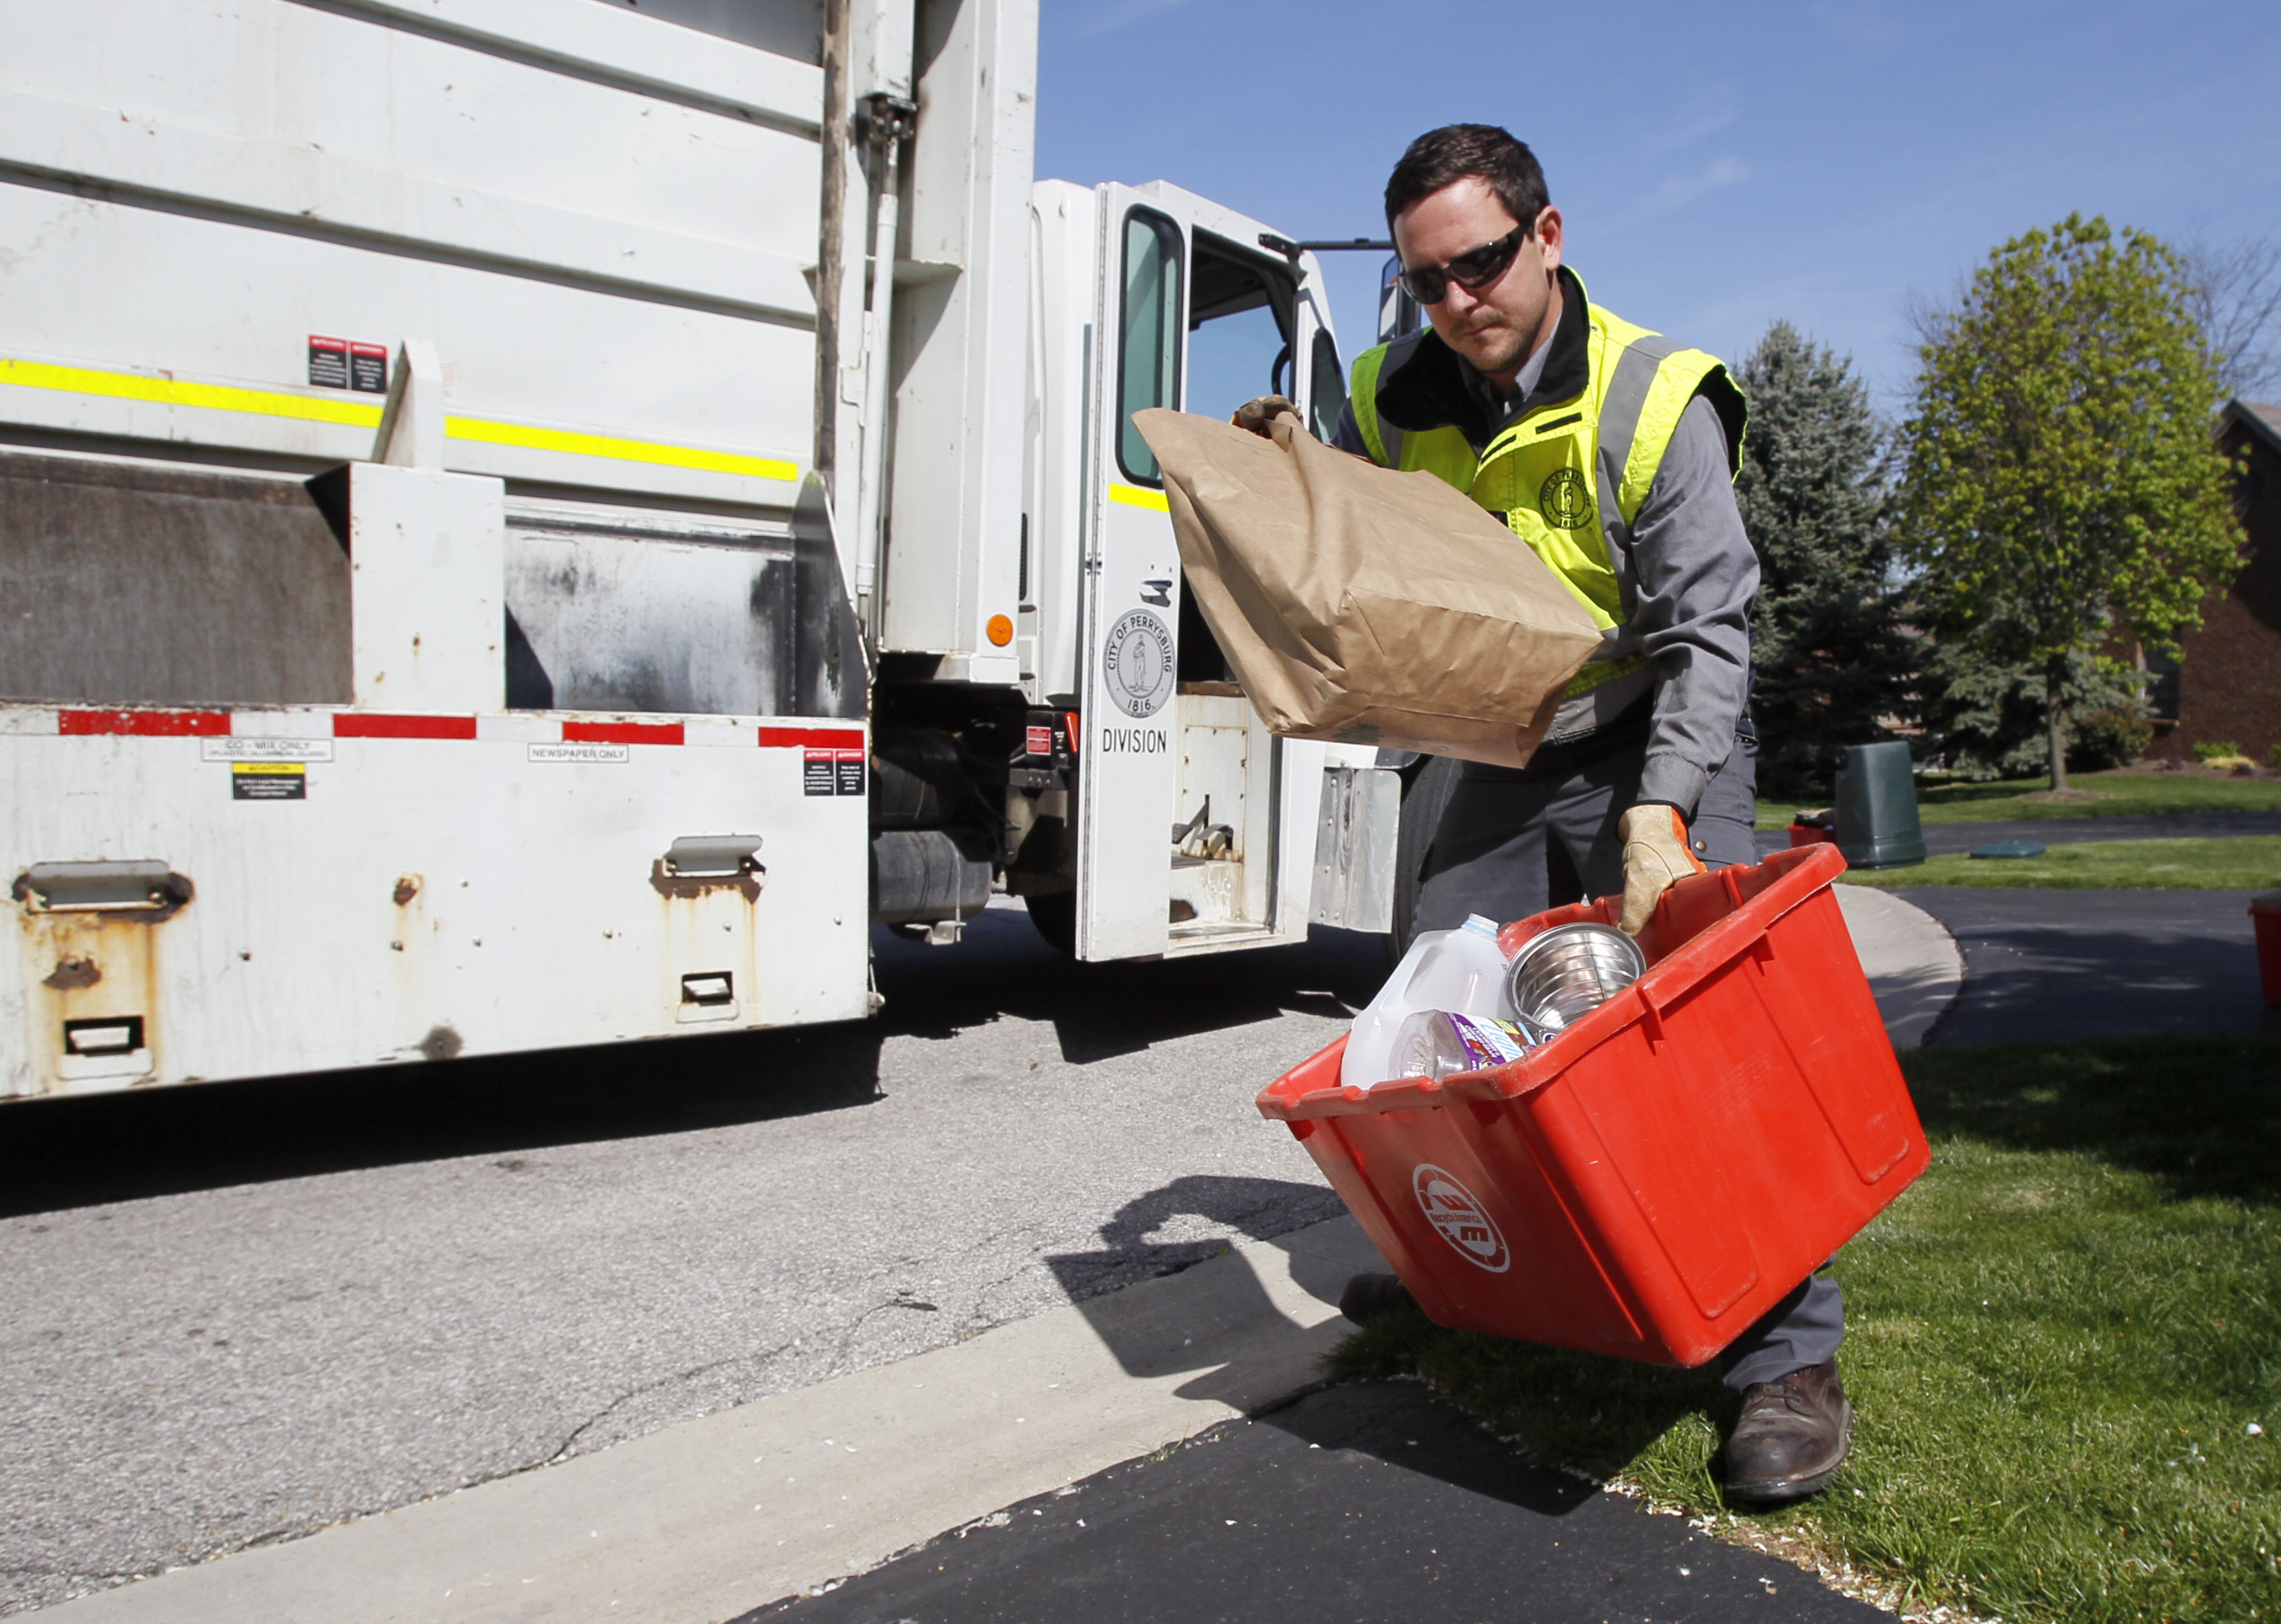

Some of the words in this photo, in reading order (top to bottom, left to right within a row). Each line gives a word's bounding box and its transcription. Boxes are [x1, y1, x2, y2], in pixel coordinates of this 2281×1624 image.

[1543, 484, 1553, 502] CITY
[1551, 474, 1560, 486] OF
[1107, 640, 1119, 670] CITY
[1116, 622, 1128, 640] OF
[1130, 615, 1172, 673] PERRYSBURG
[1128, 698, 1151, 712] 1816
[532, 748, 597, 758] NEWSPAPER
[598, 749, 625, 759] ONLY
[1102, 728, 1166, 754] DIVISION
[1480, 1024, 1522, 1060] Ligh
